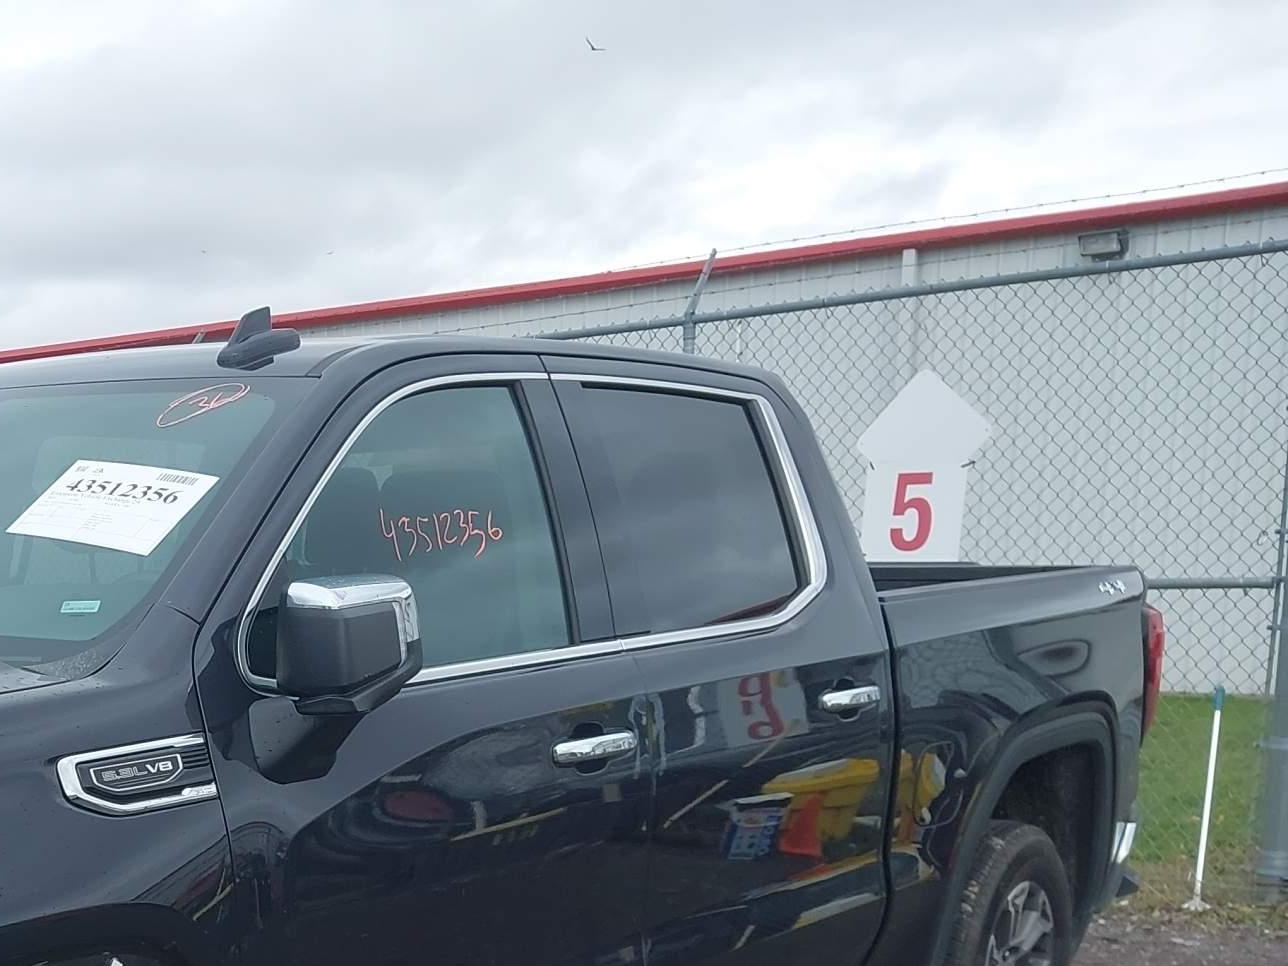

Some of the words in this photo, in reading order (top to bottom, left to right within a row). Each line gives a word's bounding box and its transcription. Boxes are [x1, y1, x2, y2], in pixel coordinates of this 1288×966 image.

[66, 477, 184, 505] 43512356
[889, 471, 934, 552] 5
[379, 507, 503, 562] 43512356
